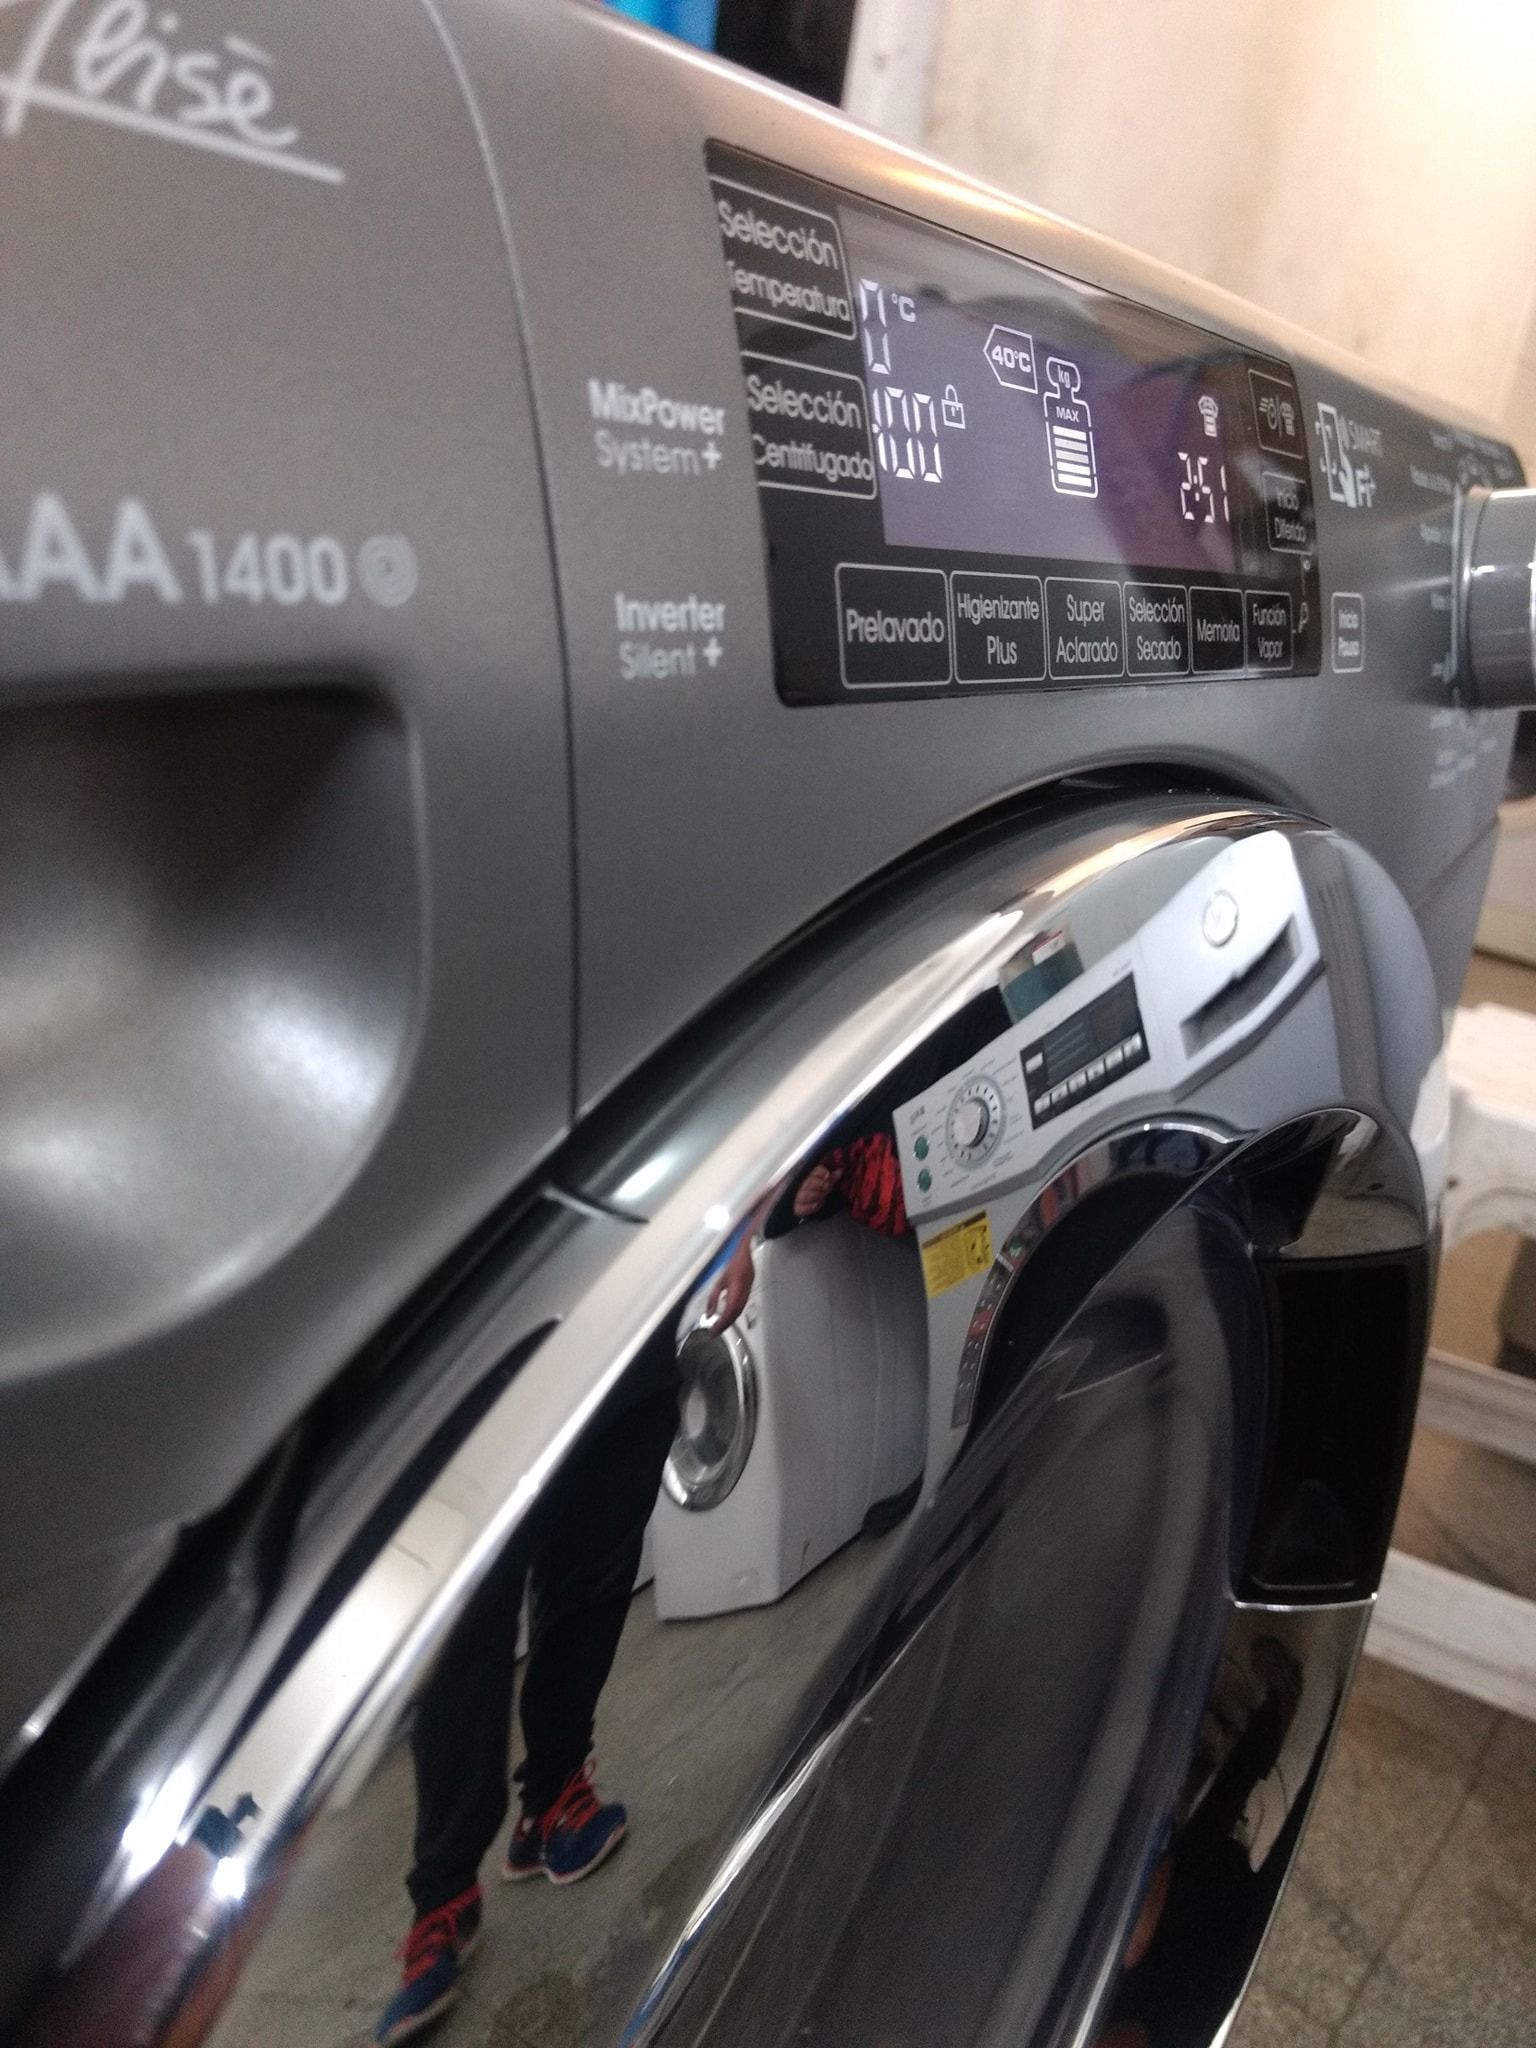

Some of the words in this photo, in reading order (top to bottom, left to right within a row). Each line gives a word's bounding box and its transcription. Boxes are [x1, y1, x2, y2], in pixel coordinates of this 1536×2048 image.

[718, 200, 839, 270] Selección
[991, 345, 1031, 373] 40°C
[1057, 365, 1071, 389] kg
[588, 377, 725, 436] MixPower
[748, 374, 862, 429] Selección
[1055, 406, 1080, 423] MAX
[752, 433, 874, 483] Centrifugado
[186, 528, 350, 608] 1400
[614, 591, 726, 632] Inverter
[957, 592, 1040, 625] Higienizante
[1066, 593, 1105, 628] Super
[1128, 595, 1186, 623] Selección
[1252, 602, 1288, 627] Función
[846, 608, 945, 644] Prelavado
[1196, 618, 1241, 643] Memoria
[986, 635, 1018, 665] Plus
[1056, 635, 1119, 664] Aclarado
[1136, 635, 1182, 661] Secado
[1257, 636, 1285, 662] Vapor
